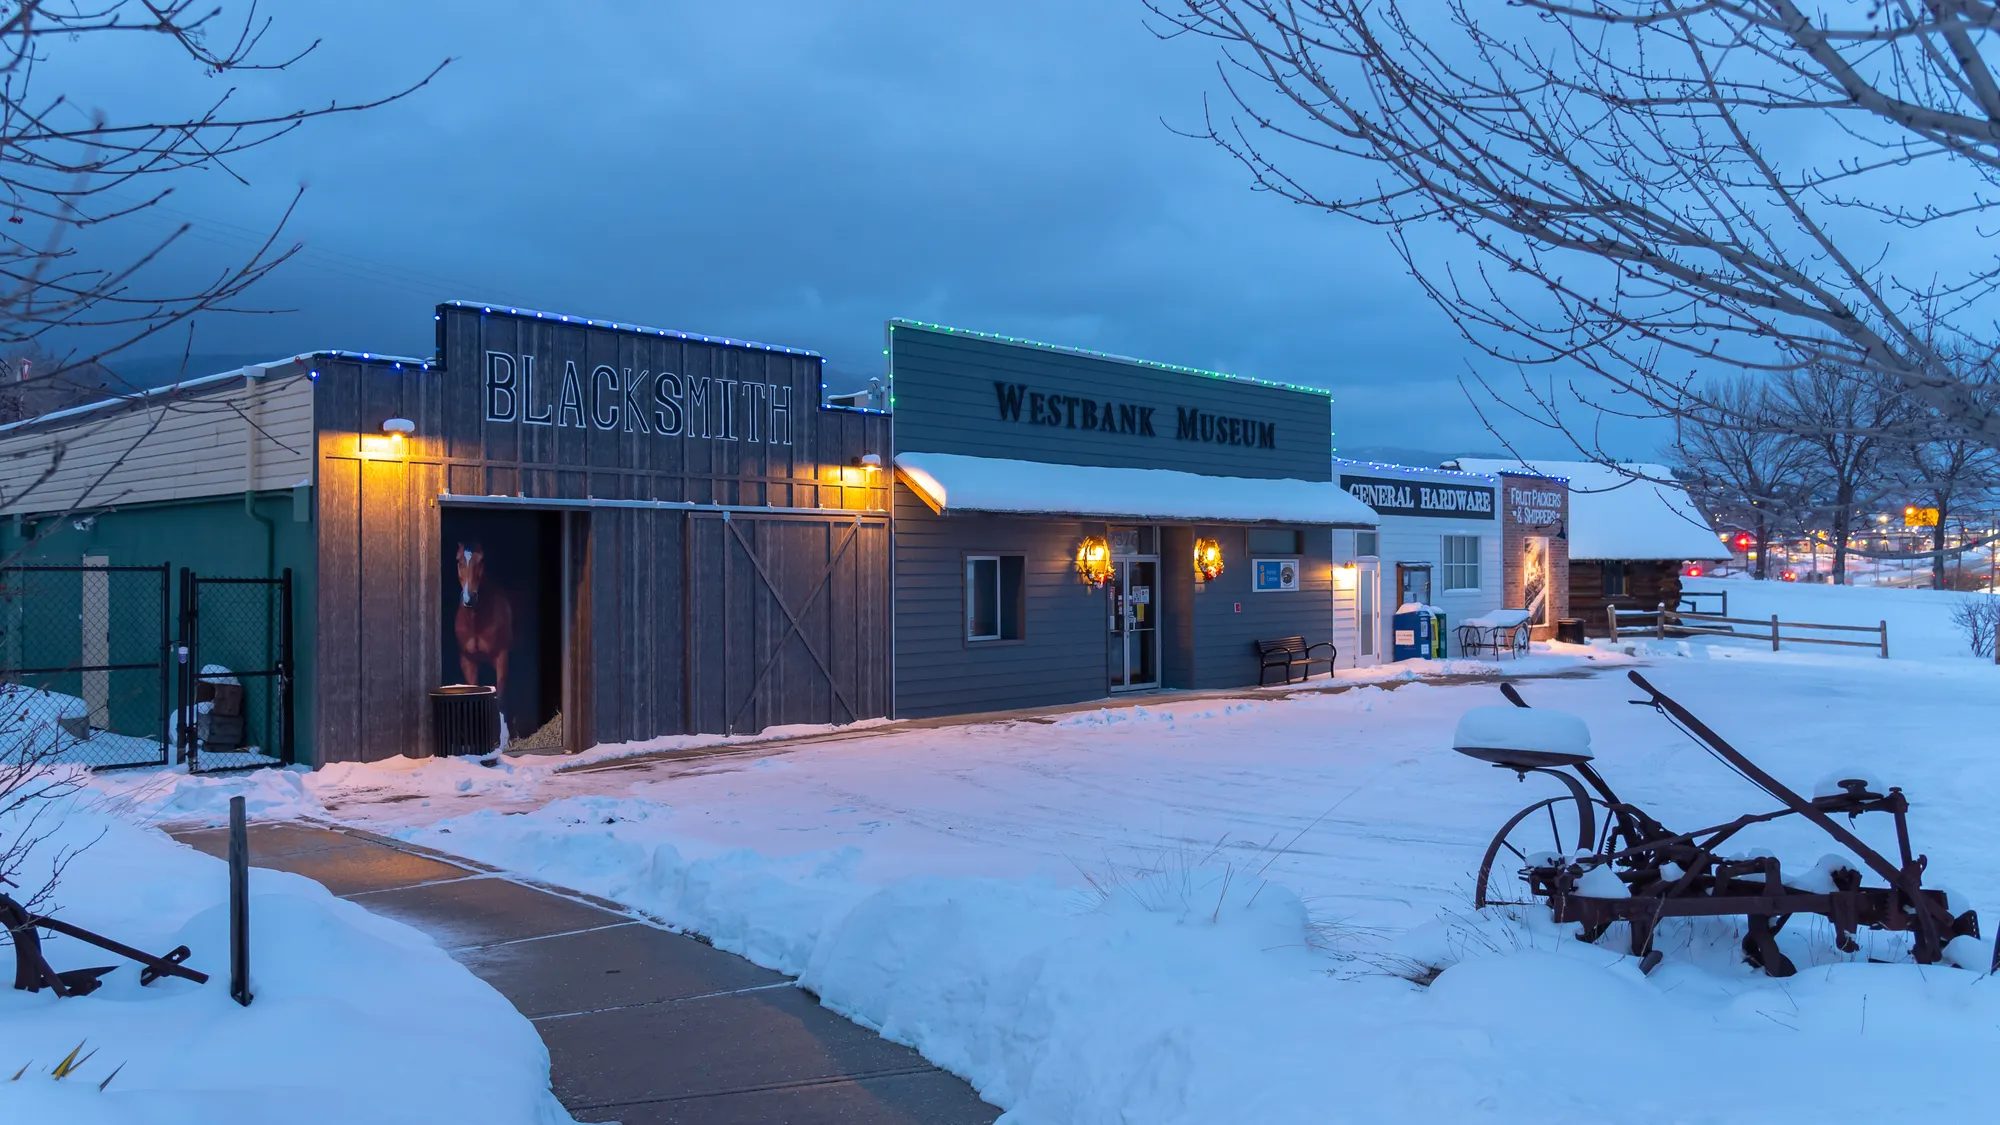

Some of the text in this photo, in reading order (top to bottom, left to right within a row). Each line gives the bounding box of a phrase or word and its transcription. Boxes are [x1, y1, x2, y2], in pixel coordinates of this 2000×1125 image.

[485, 350, 793, 445] BLACKSMITH
[993, 381, 1277, 450] WESTBANK MUSEUM
[1349, 483, 1491, 513] GENERAL HARDWARE
[1511, 487, 1561, 508] FRUIT PACKERS
[1517, 506, 1556, 525] & SHIPPERS
